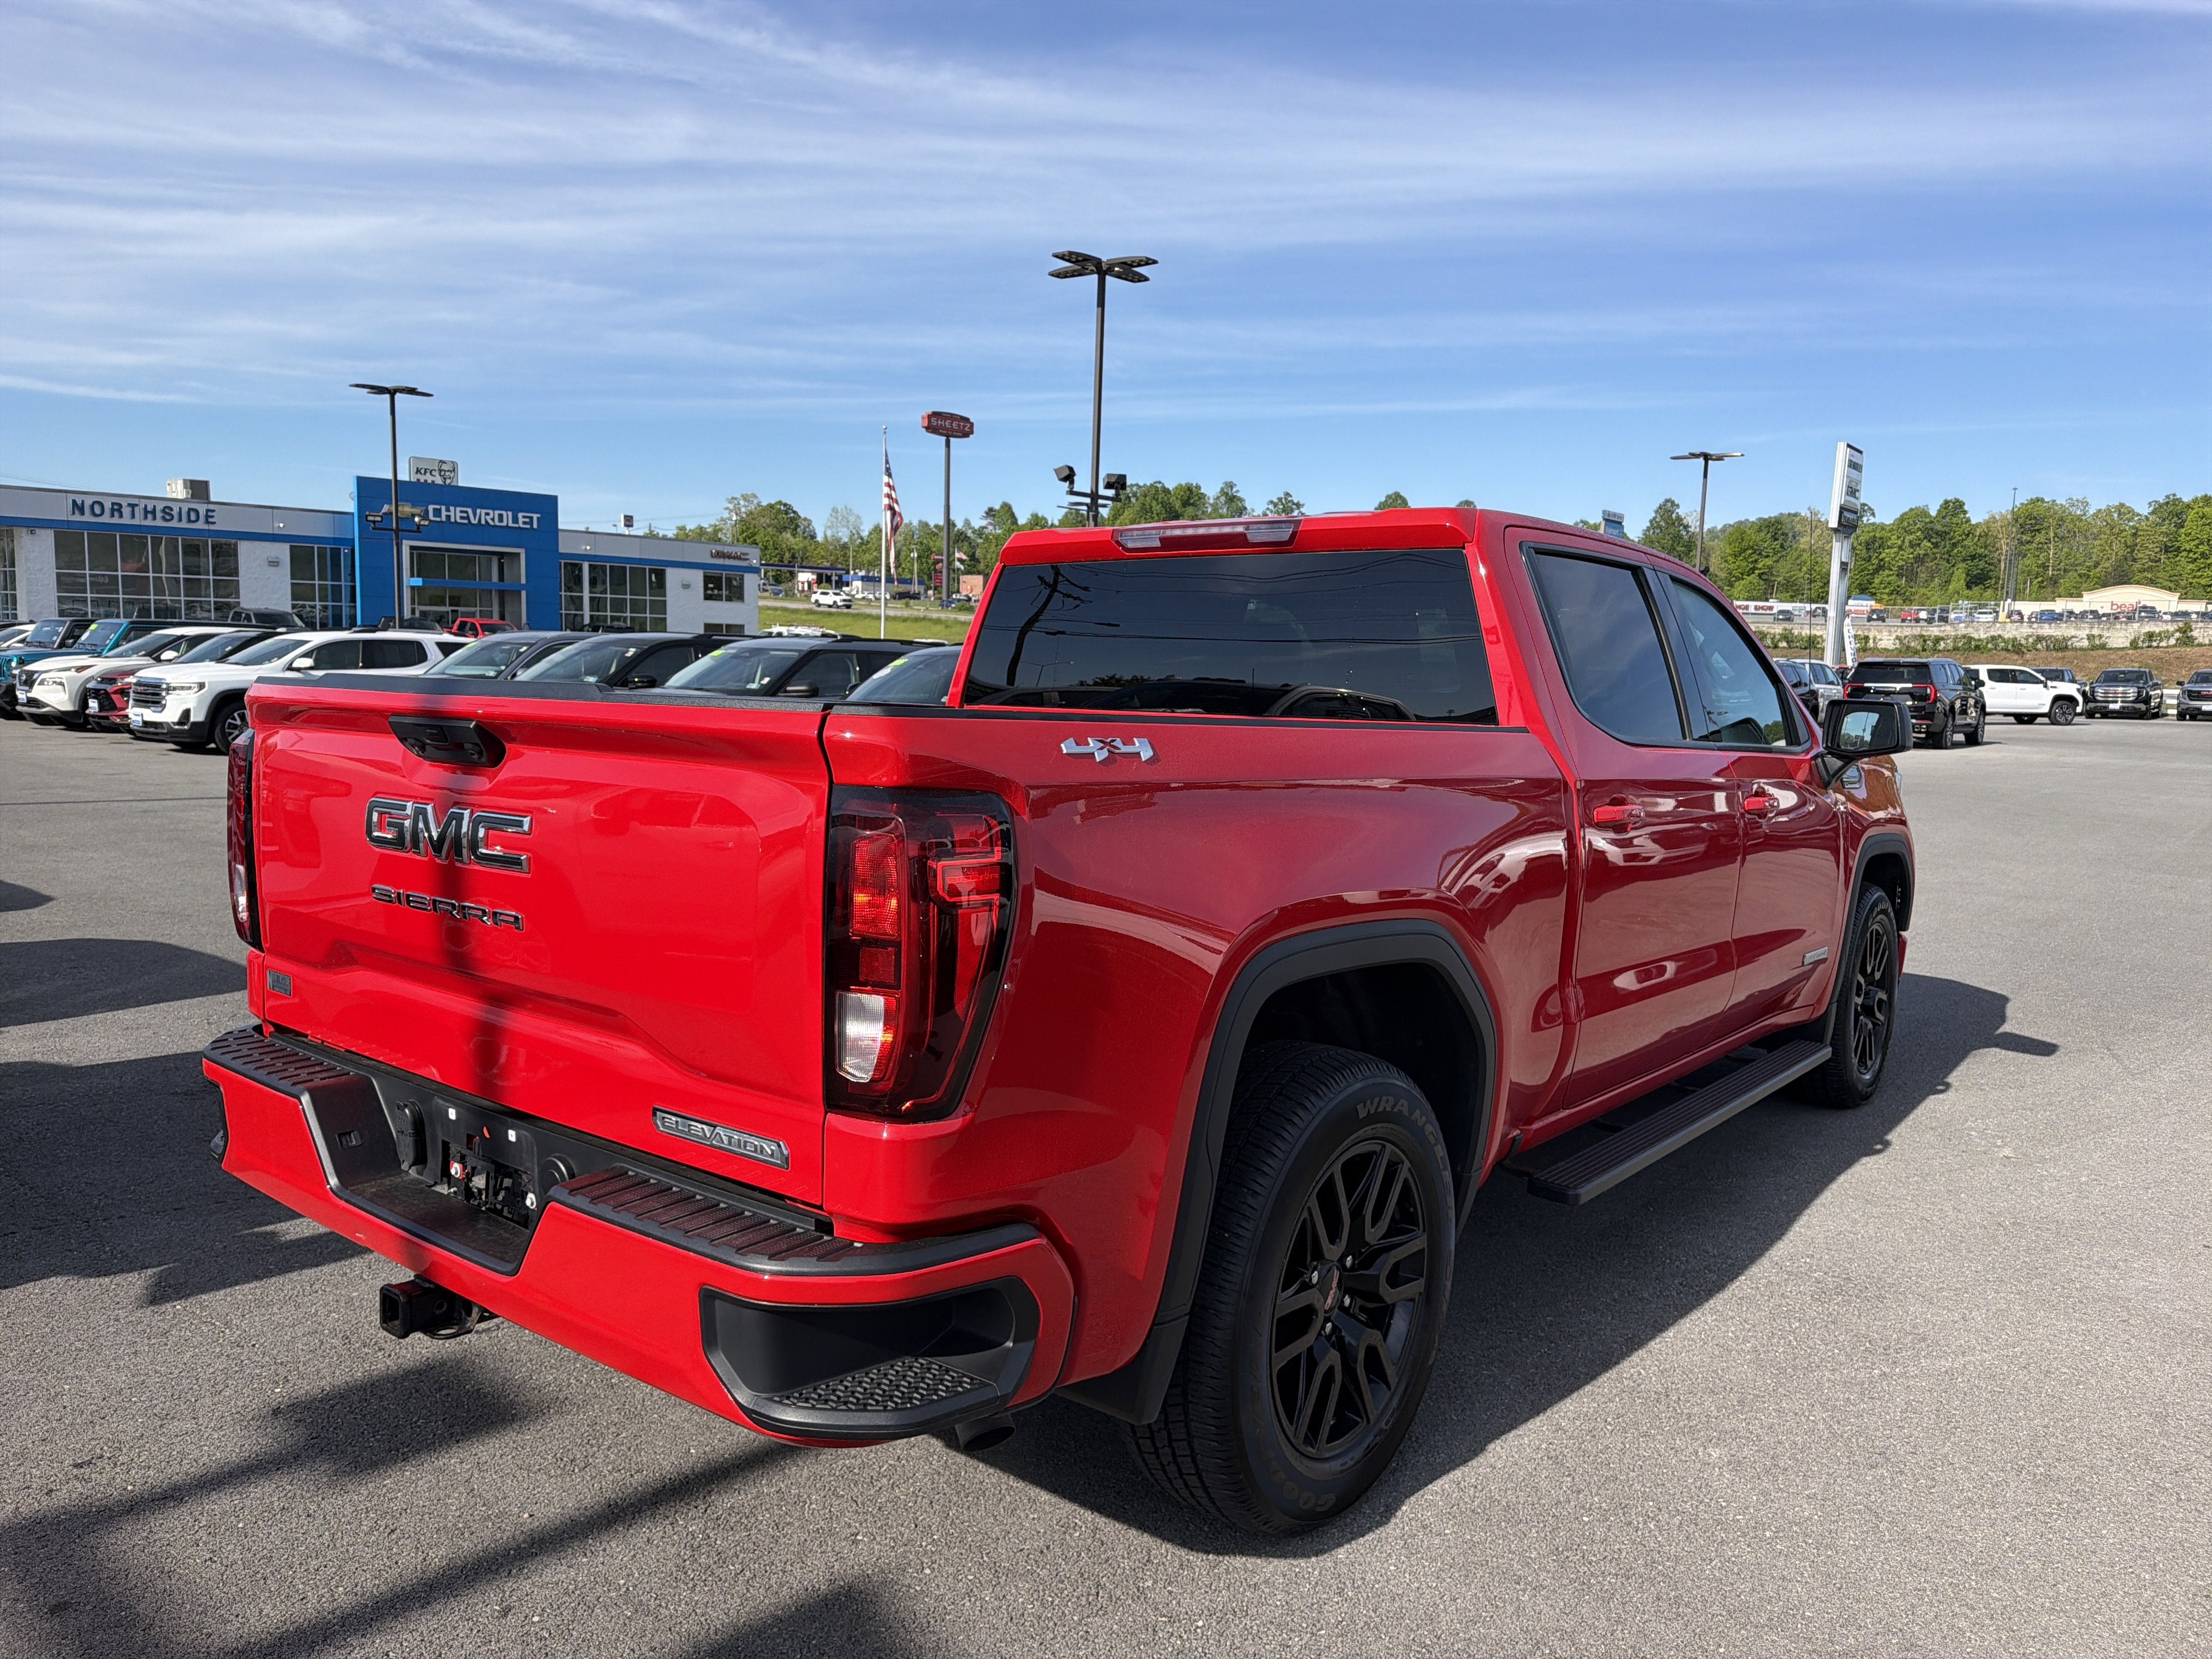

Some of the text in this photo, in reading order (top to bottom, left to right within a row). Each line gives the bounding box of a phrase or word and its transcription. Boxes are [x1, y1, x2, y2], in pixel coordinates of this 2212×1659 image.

[930, 417, 970, 431] SHEETZ
[415, 467, 437, 477] KFC
[70, 498, 217, 525] NORTHSIDE
[428, 504, 541, 529] CHEVROLET
[365, 795, 533, 874] GMC
[370, 884, 524, 932] SIERRA
[661, 1115, 775, 1156] ELEVATION
